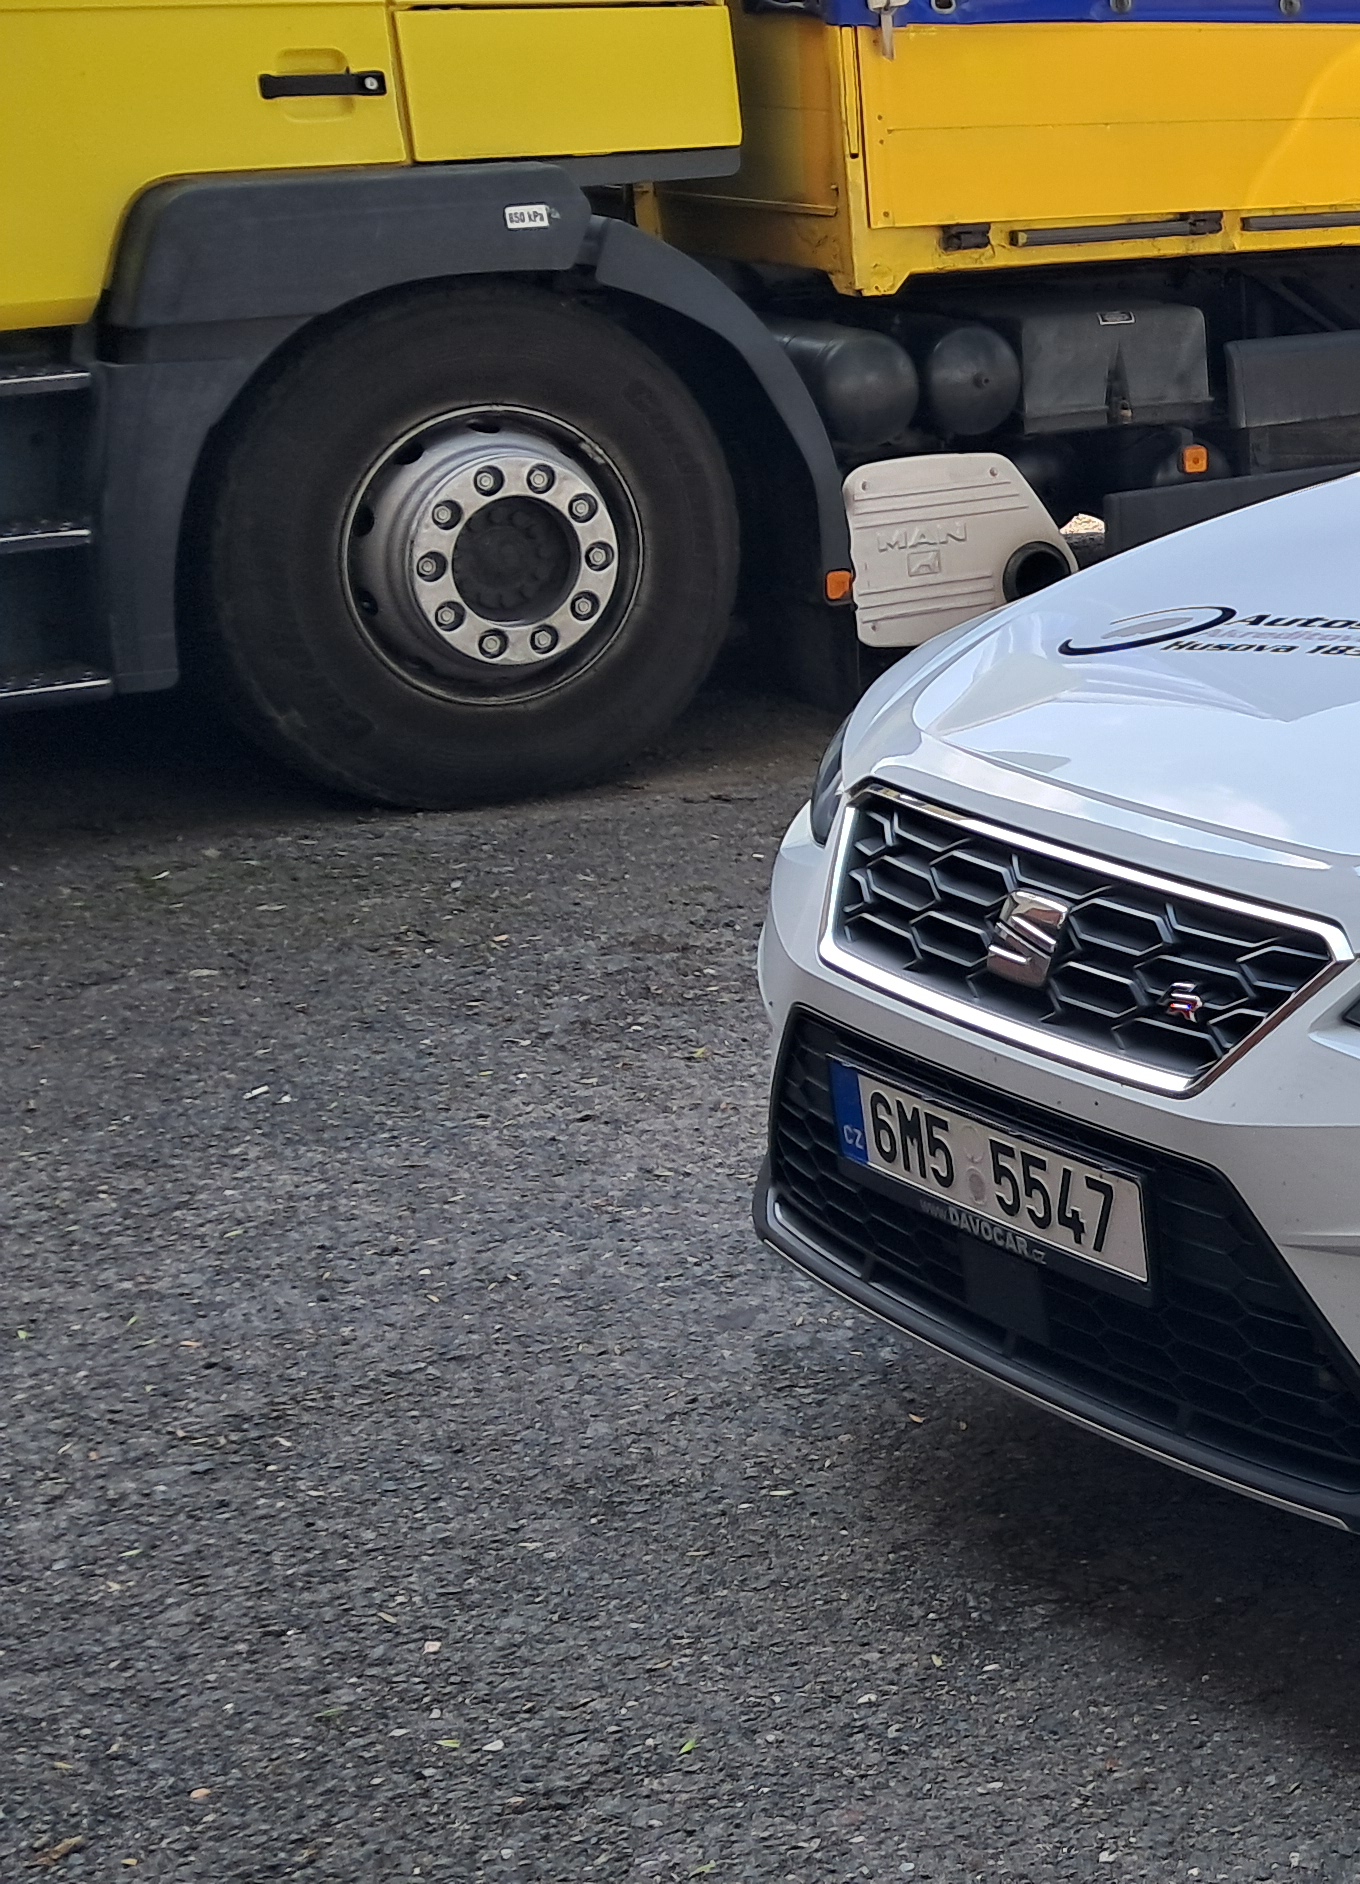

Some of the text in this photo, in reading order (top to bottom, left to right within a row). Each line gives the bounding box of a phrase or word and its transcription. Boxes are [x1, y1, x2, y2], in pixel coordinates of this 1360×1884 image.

[527, 210, 545, 222] kPa
[877, 522, 968, 553] MAN
[1160, 640, 1300, 653] Husova
[843, 1090, 1114, 1253] CZ 6M5 5547
